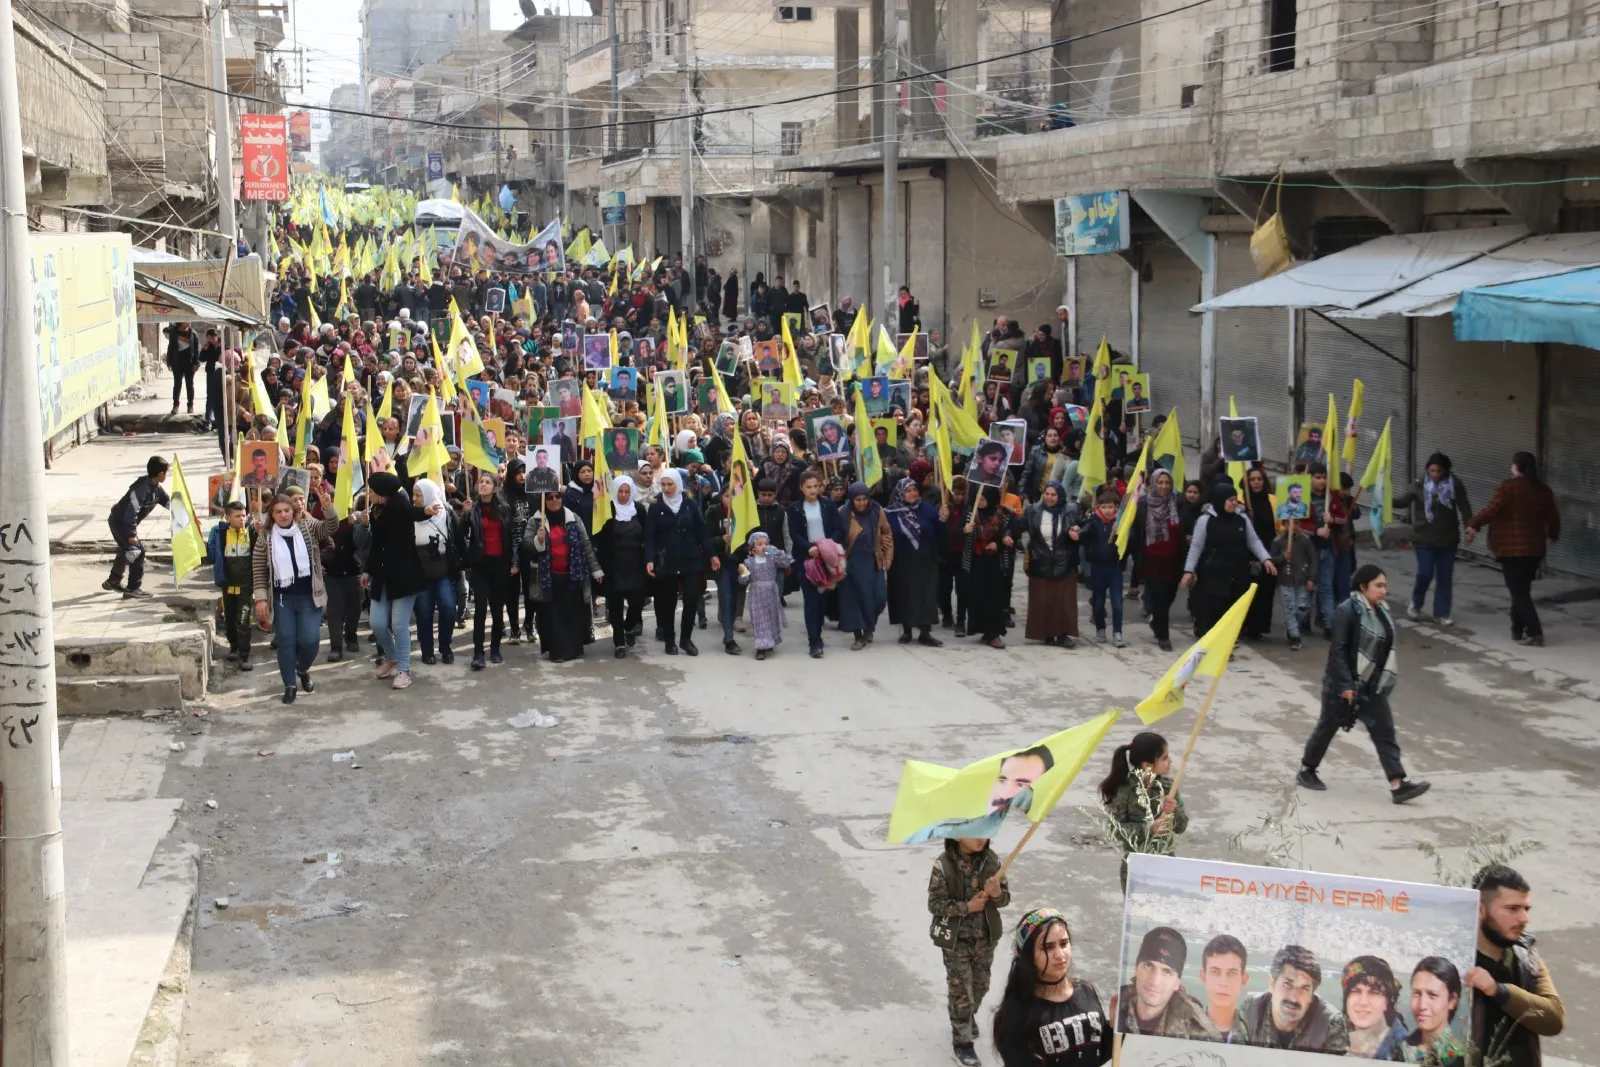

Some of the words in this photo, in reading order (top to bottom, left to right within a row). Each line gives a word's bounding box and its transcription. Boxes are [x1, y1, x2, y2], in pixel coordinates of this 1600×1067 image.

[243, 117, 284, 131] صيدلية
[244, 131, 285, 148] مجيد
[1332, 889, 1410, 913] EFRÎNÊ
[1039, 1011, 1102, 1054] BTS
